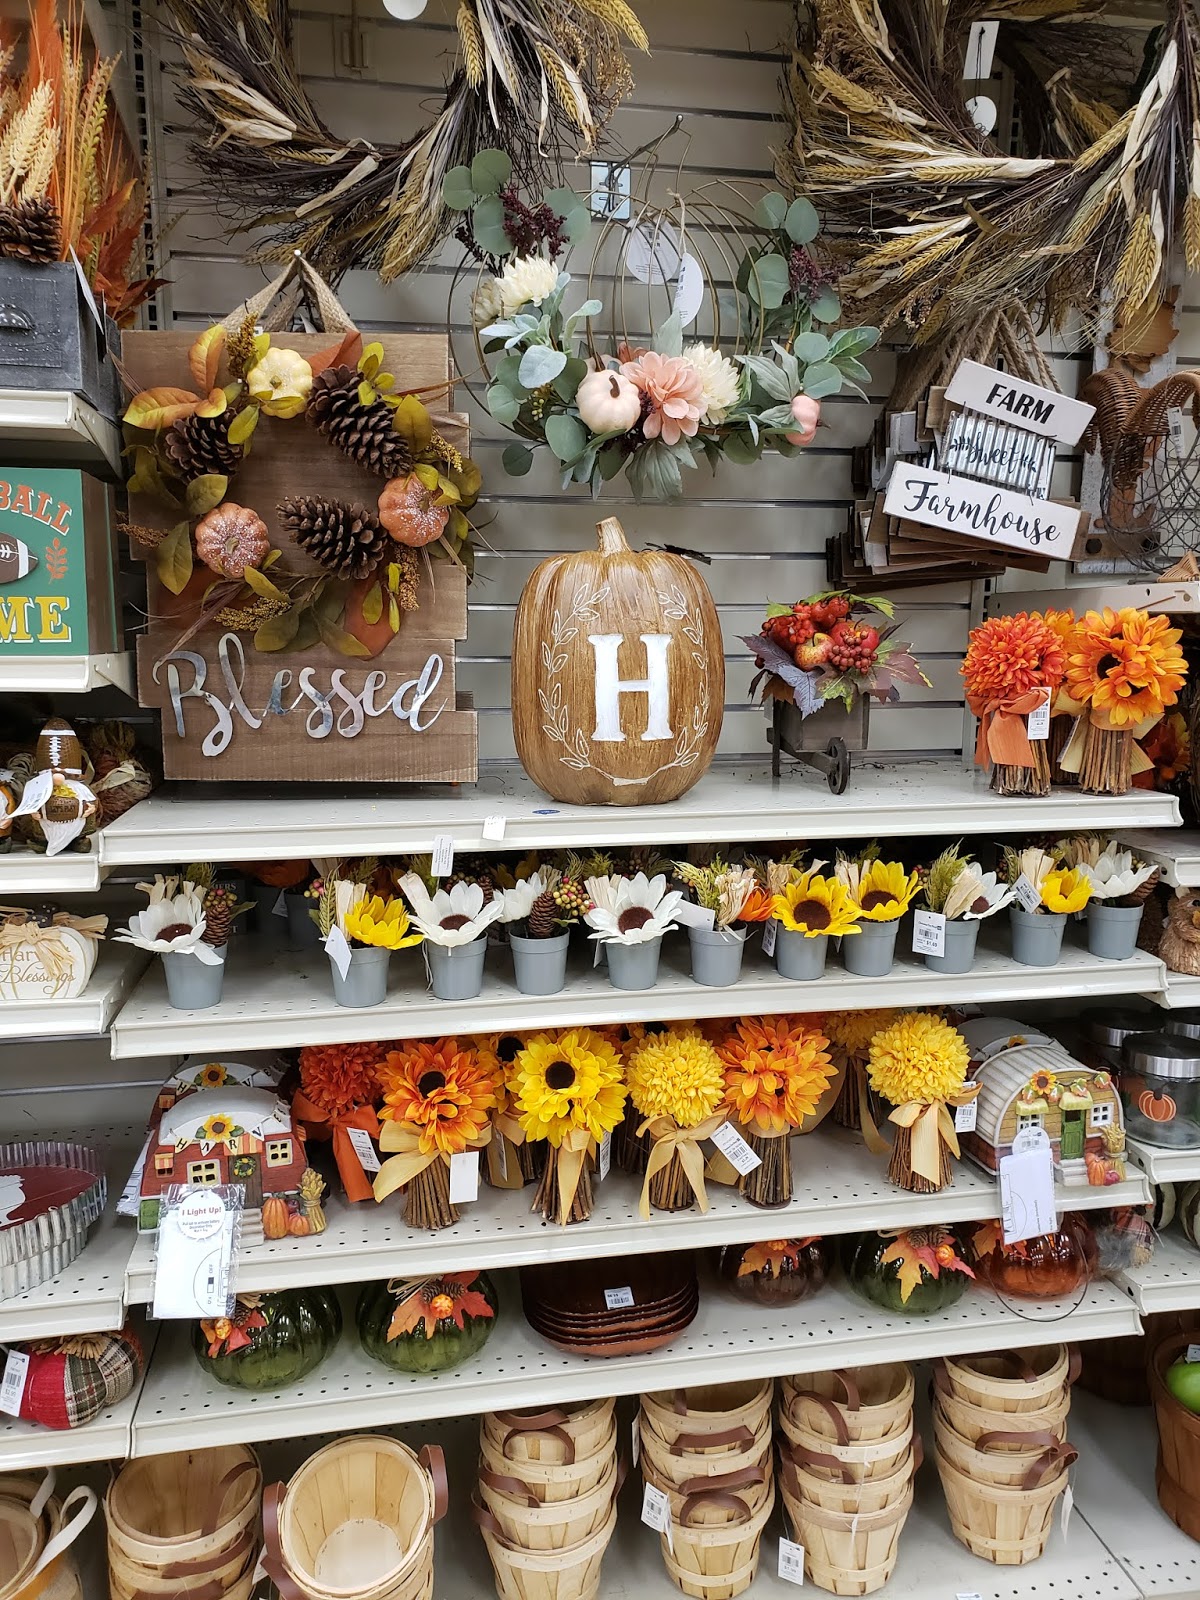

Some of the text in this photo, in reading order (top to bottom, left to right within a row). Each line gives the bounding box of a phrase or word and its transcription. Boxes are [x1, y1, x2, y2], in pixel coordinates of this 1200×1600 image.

[985, 383, 1055, 424] FARM
[966, 432, 1020, 474] Sweet
[904, 479, 1061, 546] Farmhouse
[153, 637, 448, 757] Blessed
[588, 634, 675, 741] H
[187, 1208, 207, 1217] Light
[208, 1206, 222, 1215] Up!
